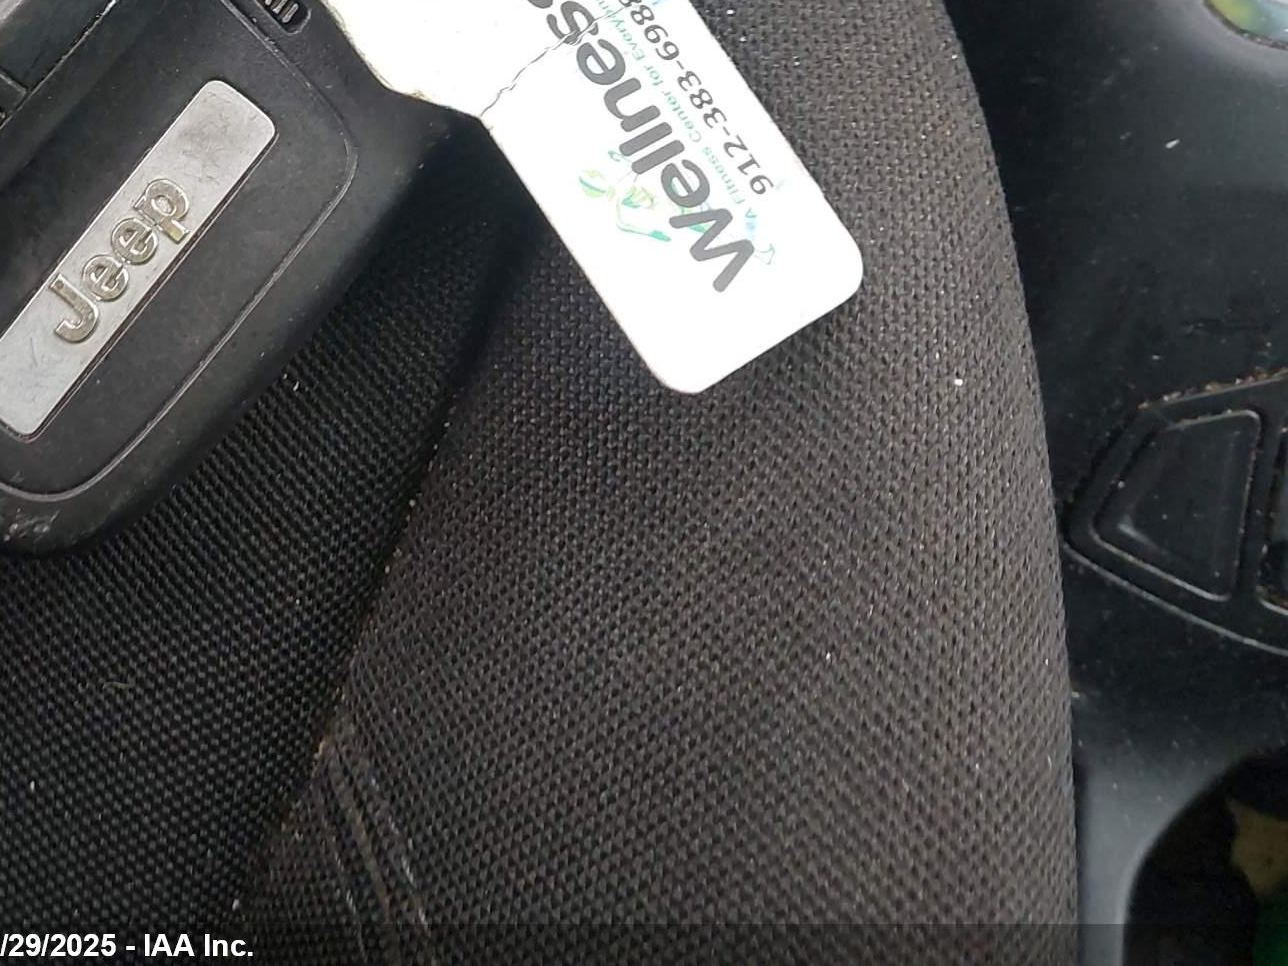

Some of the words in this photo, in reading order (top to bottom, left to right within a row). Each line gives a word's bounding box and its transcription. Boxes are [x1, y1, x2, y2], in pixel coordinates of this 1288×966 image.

[644, 63, 665, 87] for
[660, 90, 703, 144] Center
[703, 144, 746, 205] Fitness
[49, 178, 192, 344] Jeep
